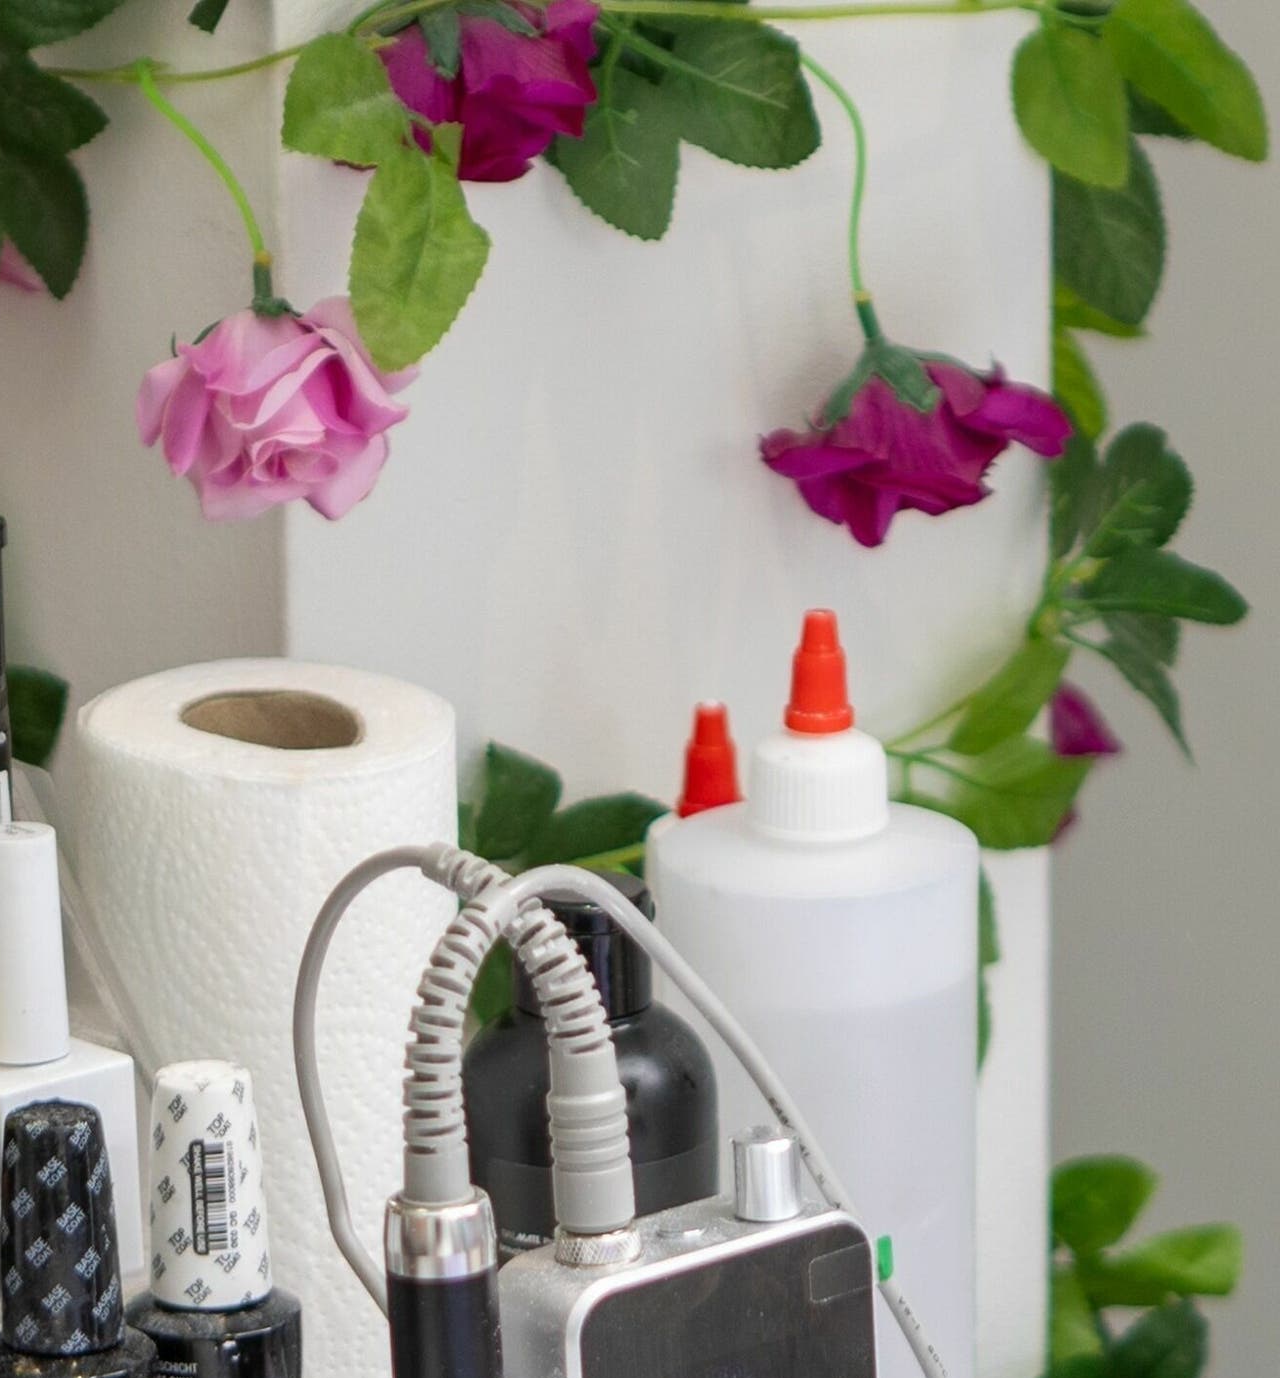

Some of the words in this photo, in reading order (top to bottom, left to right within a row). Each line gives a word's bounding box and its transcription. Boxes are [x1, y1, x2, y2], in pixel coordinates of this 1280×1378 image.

[168, 1094, 182, 1114] TOP
[173, 1104, 188, 1124] COAT
[206, 1112, 224, 1134] TOP
[37, 1155, 62, 1182] BASE
[192, 1143, 204, 1173] SHAKE
[46, 1164, 68, 1188] COAT
[56, 1202, 80, 1228] BASE
[65, 1210, 86, 1233] COAT
[195, 1199, 206, 1233] BEFORE
[24, 1236, 48, 1260] BASE
[168, 1227, 185, 1247] TOP
[33, 1246, 54, 1267] COAT
[75, 1244, 97, 1273] BASE
[41, 1283, 66, 1308] BASE
[184, 1278, 204, 1298] TOP
[193, 1286, 213, 1305] COAT
[51, 1292, 72, 1313] COAT
[157, 1361, 198, 1374] SCHICHT
